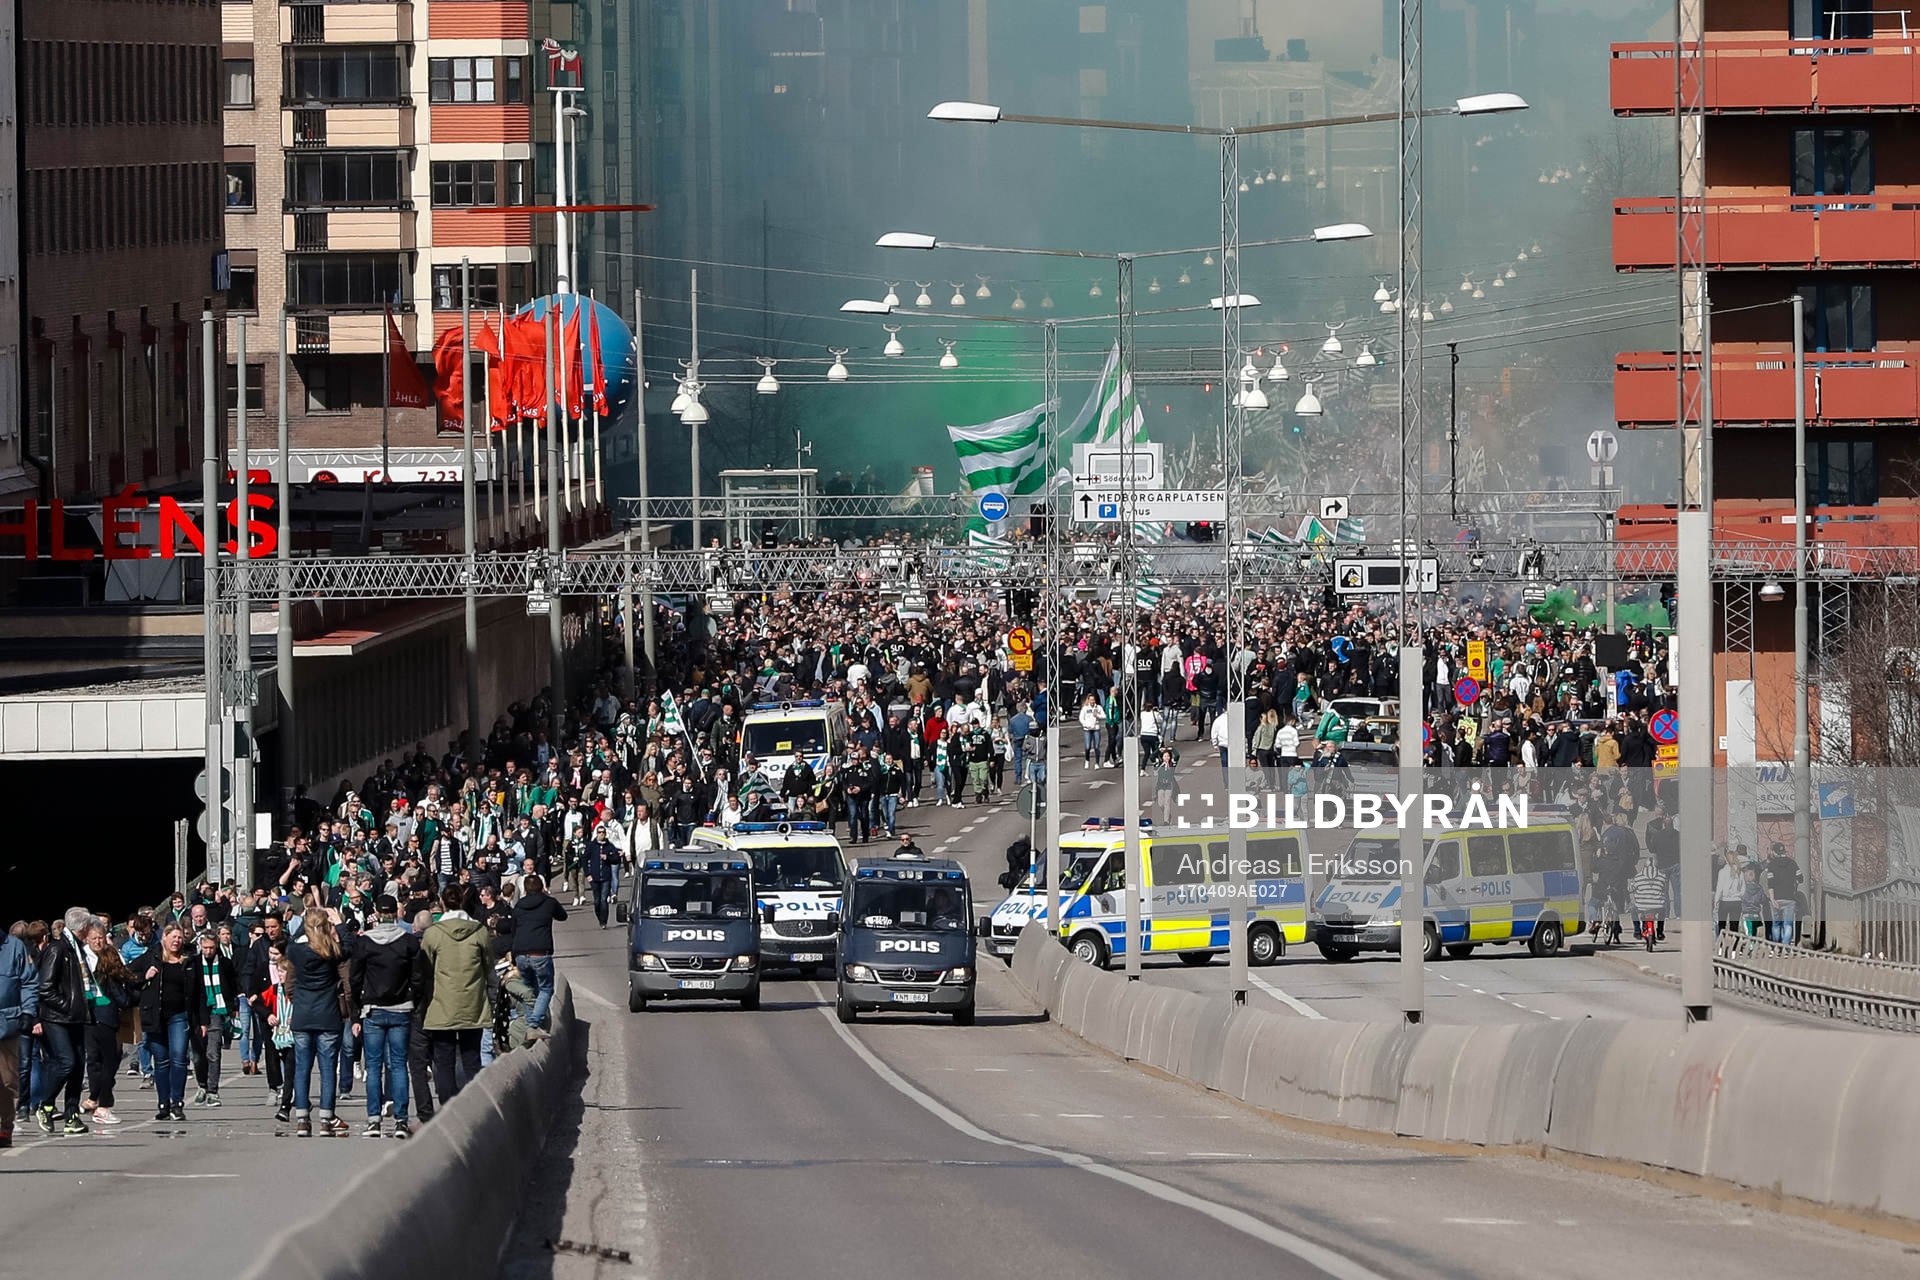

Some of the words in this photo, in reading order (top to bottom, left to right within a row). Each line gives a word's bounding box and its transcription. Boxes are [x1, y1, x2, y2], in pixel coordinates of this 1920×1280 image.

[1097, 492, 1225, 503] MEDBORGARPLATSEN
[1416, 569, 1433, 583] kr
[1756, 766, 1792, 782] MJ
[1481, 880, 1512, 897] POLIS
[1166, 889, 1210, 906] POLIS
[1329, 891, 1382, 904] POLIS
[772, 902, 835, 912] POLIS
[667, 929, 725, 942] POLIS
[880, 940, 941, 954] POLIS
